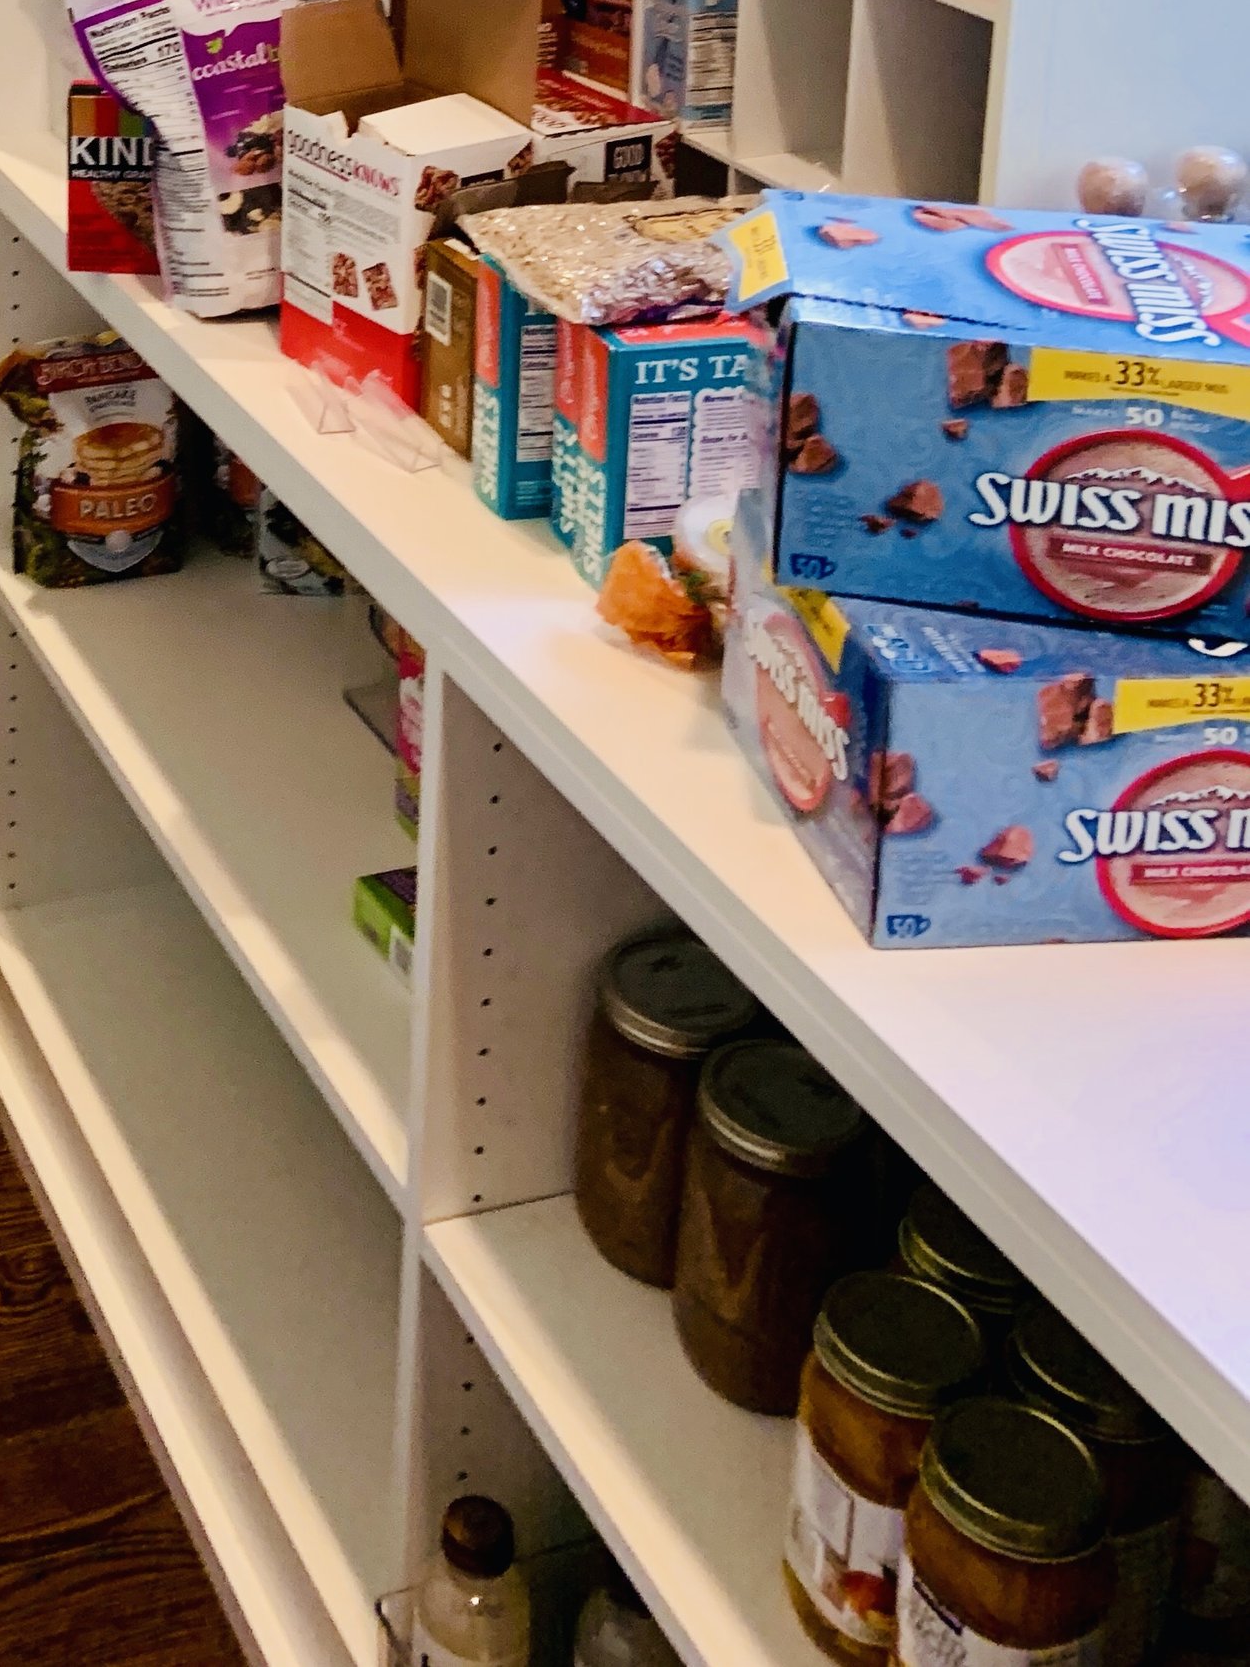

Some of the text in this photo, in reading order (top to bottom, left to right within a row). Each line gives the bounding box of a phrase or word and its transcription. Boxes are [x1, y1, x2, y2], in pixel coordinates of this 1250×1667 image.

[156, 41, 181, 58] 170
[1075, 218, 1178, 283] SWISS
[1126, 282, 1221, 348] MISS
[634, 357, 700, 385] IT'S
[1115, 360, 1162, 387] 33%
[1125, 407, 1165, 428] 50
[78, 494, 157, 519] PALEO
[968, 472, 1250, 548] SWISS MIS
[1062, 542, 1196, 567] MILK CHOCOLATE
[1203, 727, 1239, 746] 50
[1056, 808, 1218, 864] SWISS
